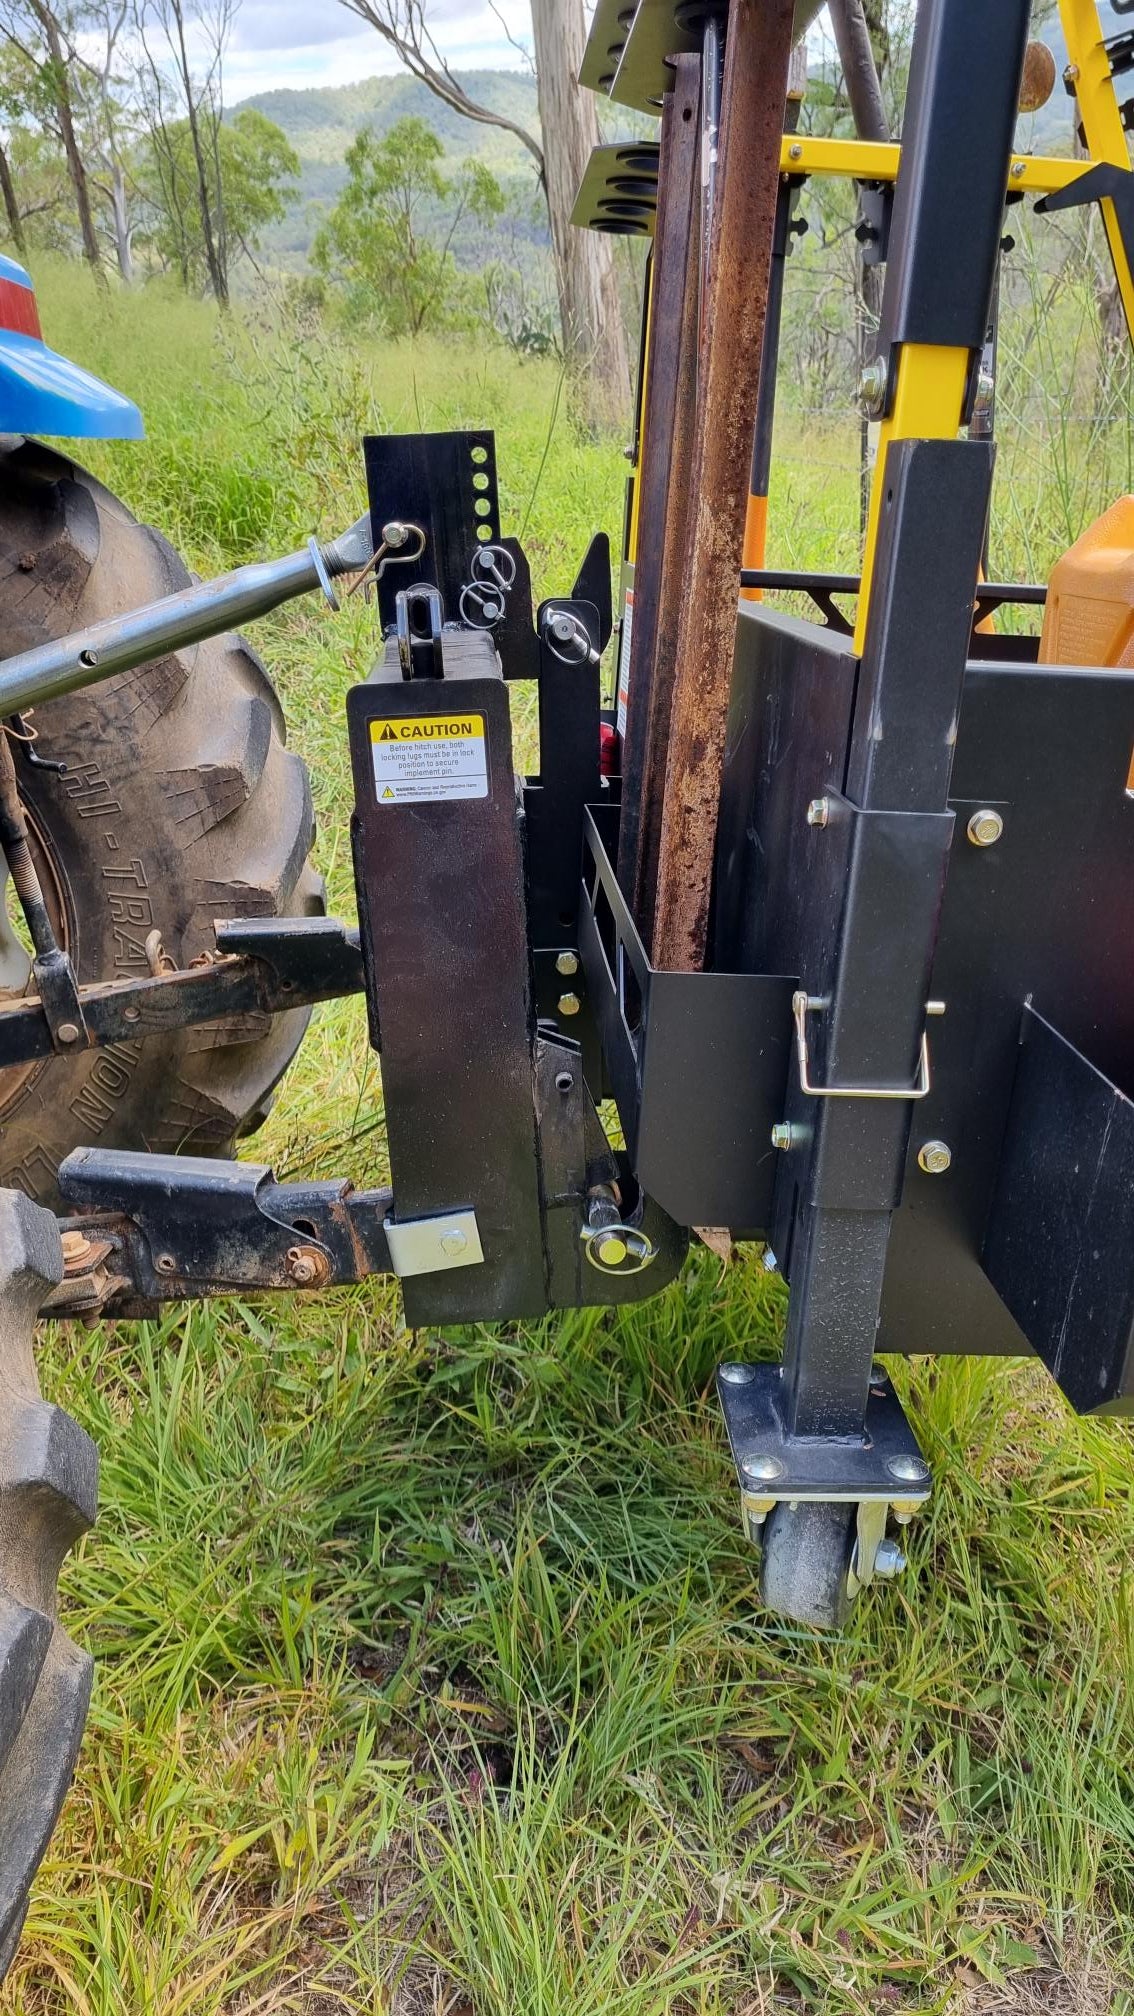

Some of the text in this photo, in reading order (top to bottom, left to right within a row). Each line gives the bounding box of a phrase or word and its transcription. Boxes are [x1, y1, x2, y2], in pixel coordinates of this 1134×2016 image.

[400, 723, 472, 738] CAUTION
[390, 744, 412, 752] Before
[415, 742, 431, 750] hitch
[381, 752, 406, 761] locking
[407, 751, 422, 760] lugs
[398, 760, 425, 769] position
[405, 768, 441, 778] implement
